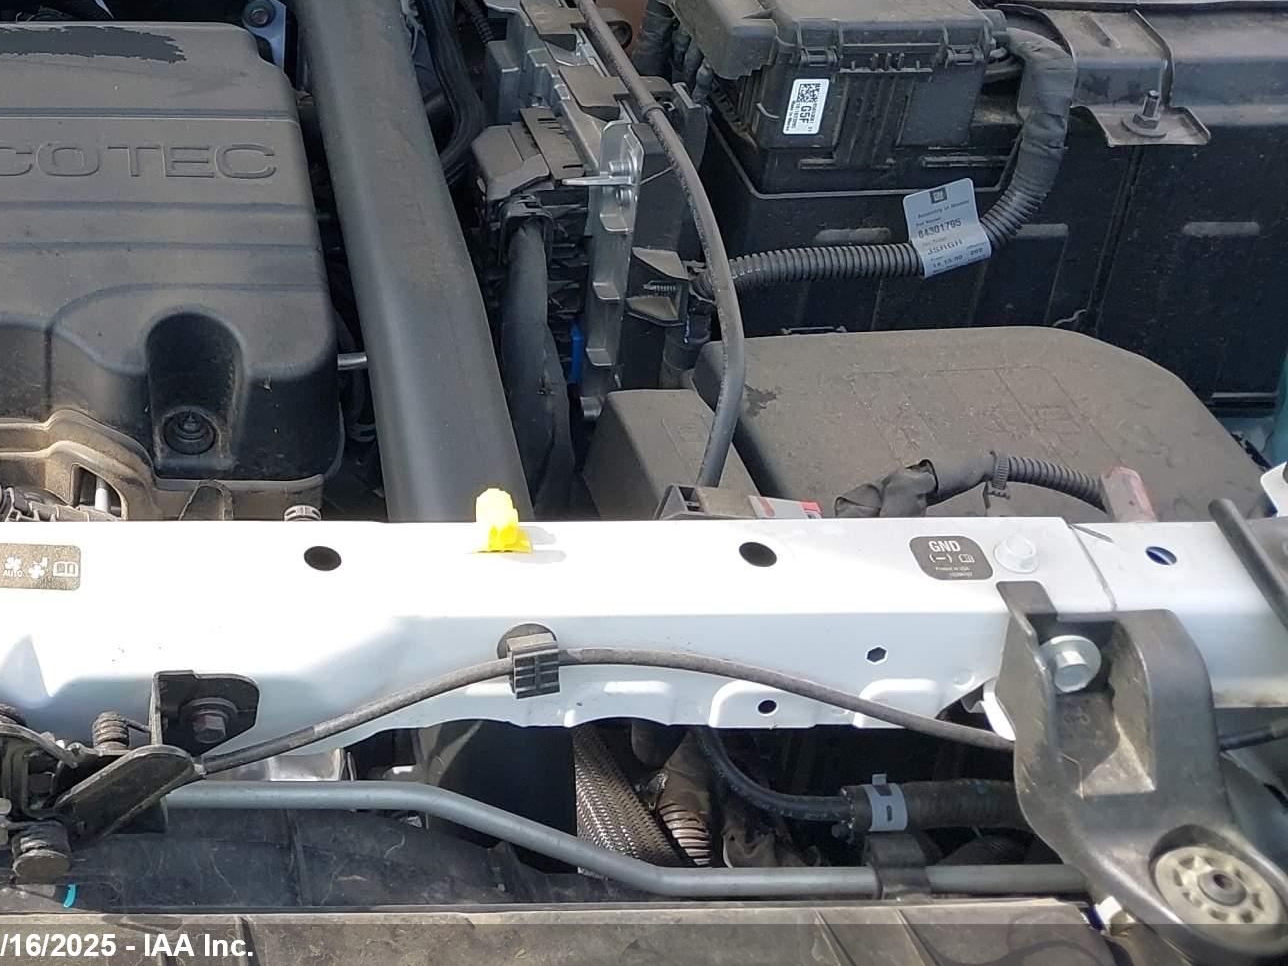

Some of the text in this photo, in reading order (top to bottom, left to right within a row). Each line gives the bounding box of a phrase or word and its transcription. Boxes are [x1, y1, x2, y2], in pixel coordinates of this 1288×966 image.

[799, 105, 812, 124] G5F
[928, 540, 961, 552] GND
[2, 569, 23, 577] AUTO
